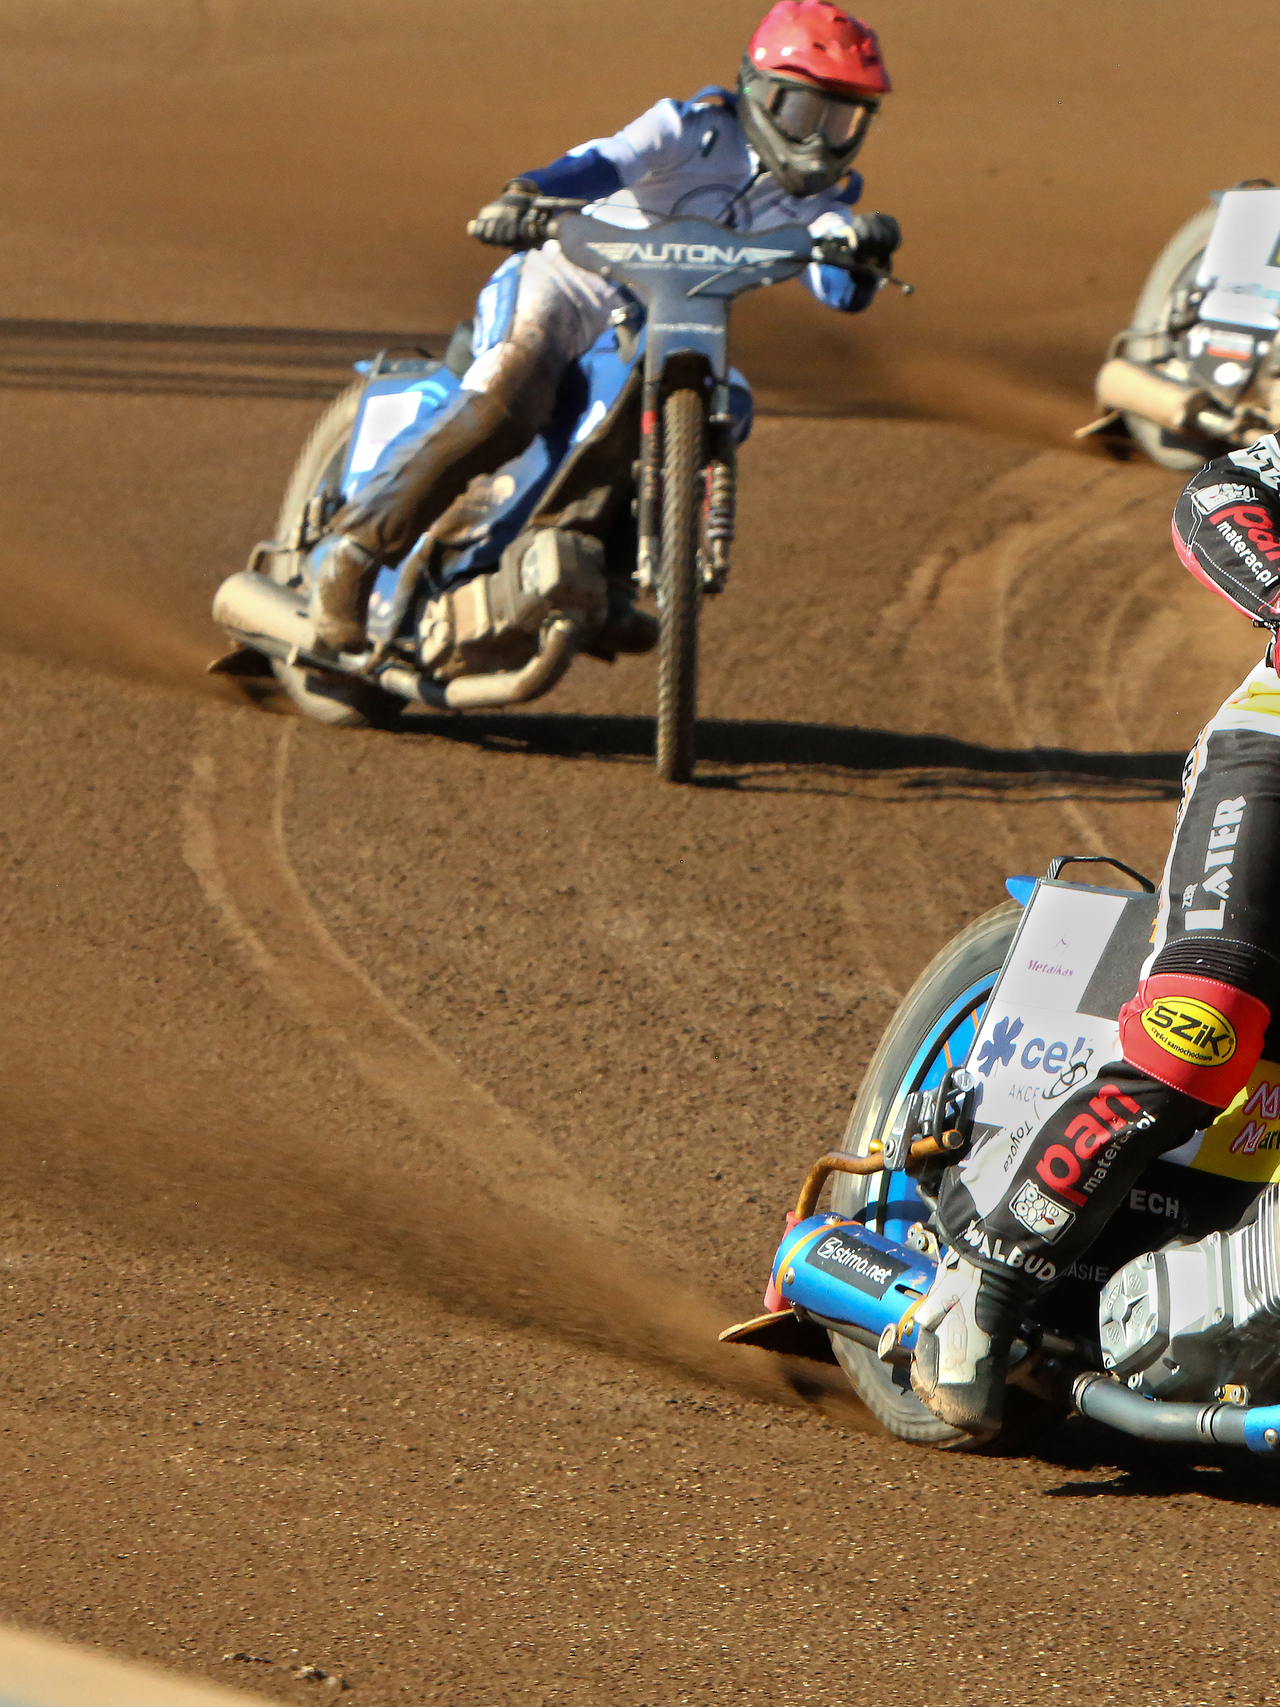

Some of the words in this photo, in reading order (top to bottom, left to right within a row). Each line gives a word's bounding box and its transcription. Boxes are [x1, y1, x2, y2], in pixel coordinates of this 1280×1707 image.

[1216, 520, 1279, 588] materac.pl
[1184, 795, 1247, 931] LATER
[1027, 959, 1074, 977] Metalkas
[1003, 1119, 1033, 1173] Toyota
[1035, 1083, 1142, 1207] pan
[831, 1246, 893, 1285] stimo.net
[963, 1221, 1058, 1281] WALBUD
